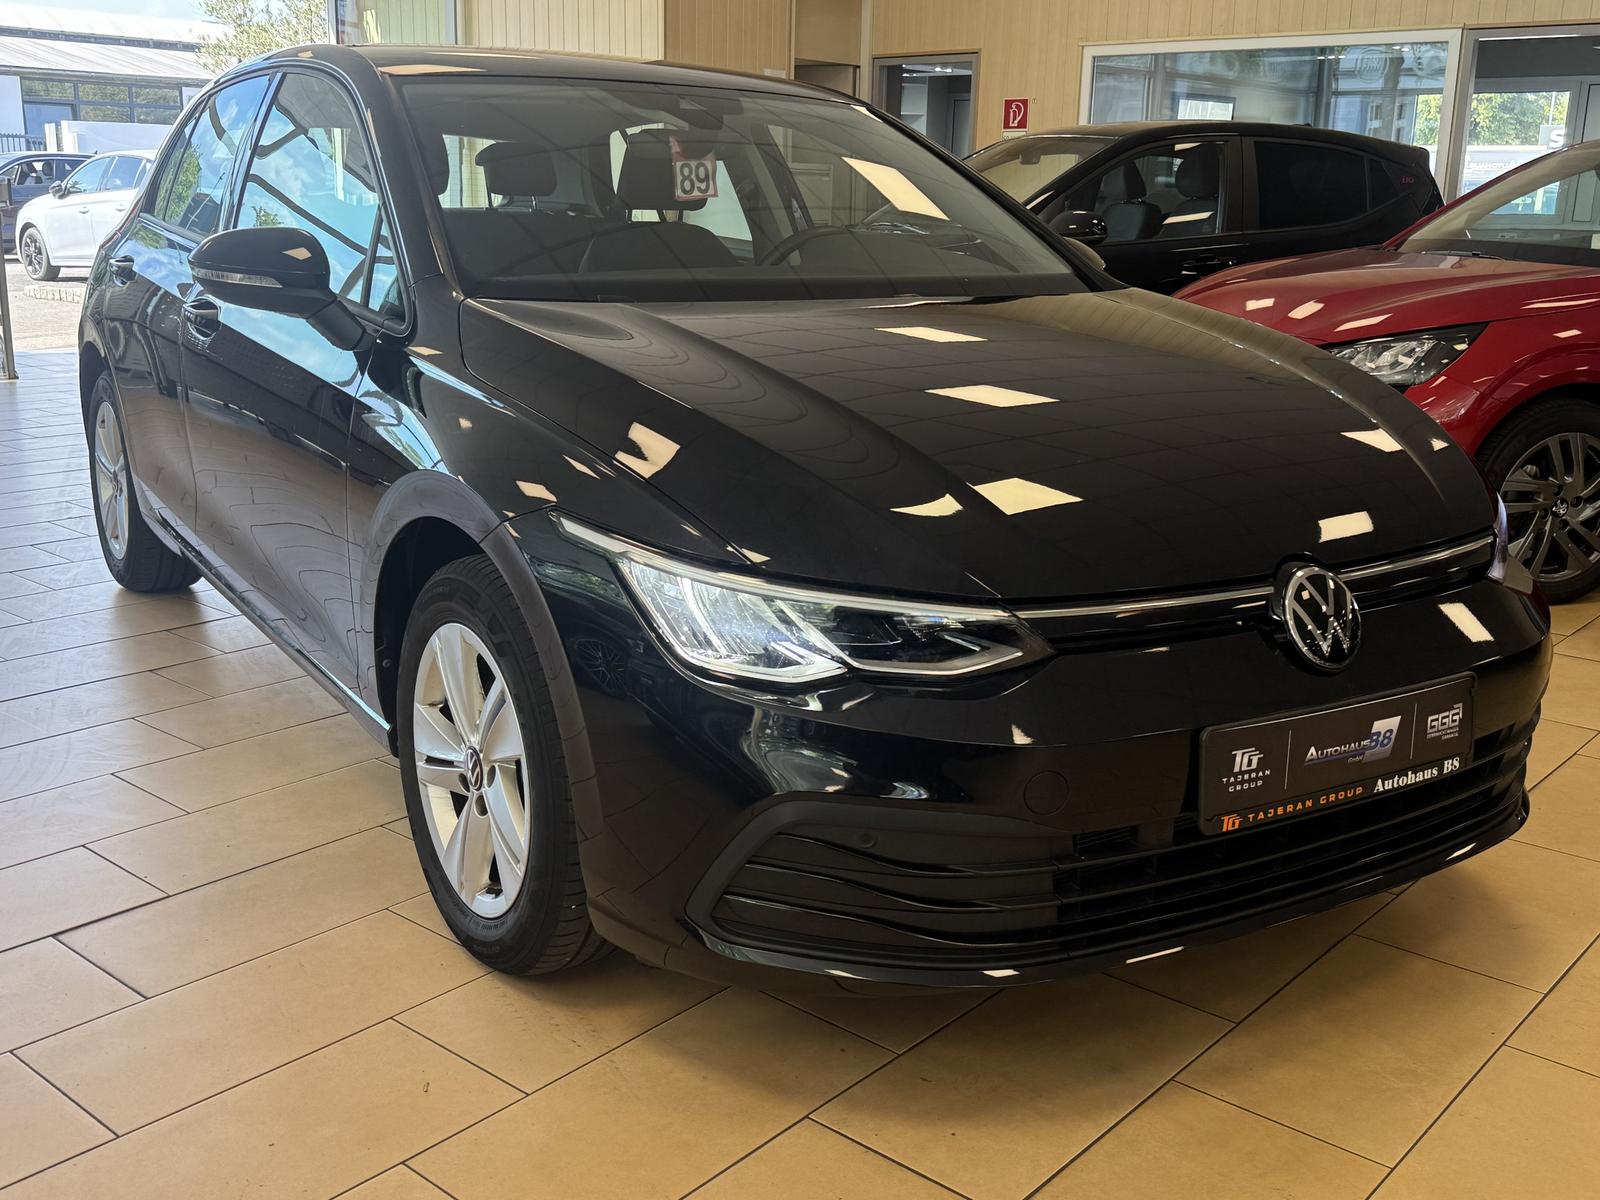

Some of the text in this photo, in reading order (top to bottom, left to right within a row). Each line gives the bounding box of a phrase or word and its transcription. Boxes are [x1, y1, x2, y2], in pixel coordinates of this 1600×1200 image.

[680, 162, 710, 195] 89
[1231, 747, 1264, 773] TG
[1222, 769, 1271, 784] TAJERAN
[1228, 780, 1263, 793] GROUP
[1374, 757, 1460, 793] Autohaus B8
[1221, 786, 1364, 832] TG TAJERAN GROUP
